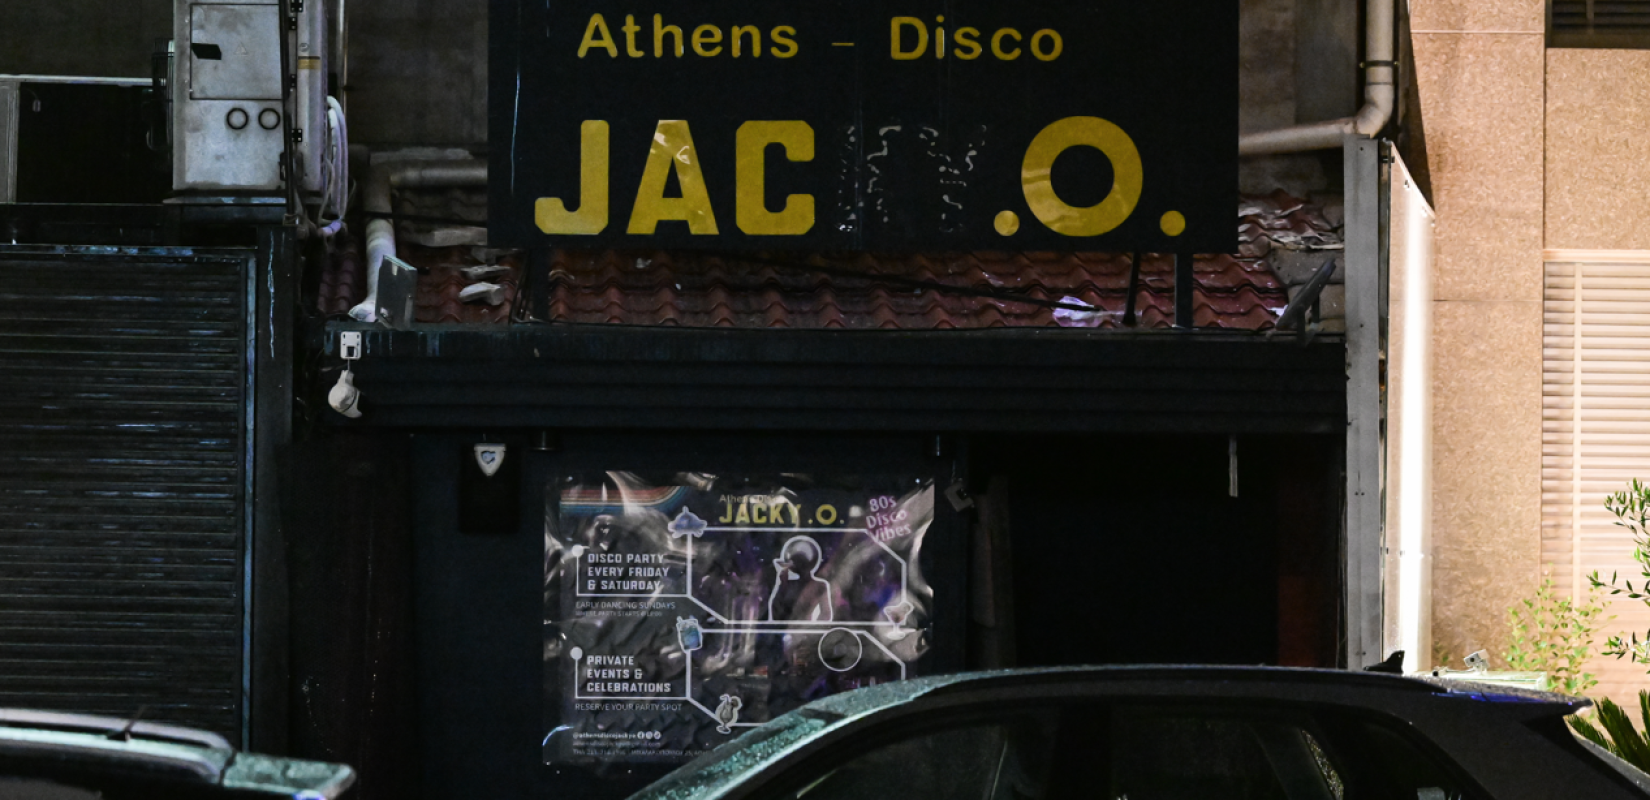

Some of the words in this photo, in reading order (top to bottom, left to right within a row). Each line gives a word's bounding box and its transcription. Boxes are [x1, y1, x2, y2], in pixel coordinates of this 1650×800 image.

[577, 13, 800, 59] Athens
[890, 15, 1063, 61] Disco
[869, 496, 896, 512] 80s
[866, 509, 907, 529] Disco
[869, 524, 911, 542] Vibes
[587, 553, 622, 564] DISCO
[626, 553, 664, 564] PARTY
[587, 567, 623, 577] EVERY
[628, 567, 669, 577] FRIDAY
[600, 580, 661, 590] SATURDAY
[586, 655, 634, 666] PRIVATE
[586, 669, 630, 679] EVENTS
[586, 682, 671, 692] CELEBRATIONS
[575, 703, 609, 711] RESERVE
[611, 703, 634, 711] YOUR
[635, 703, 659, 711] PARTY
[661, 703, 682, 711] SPOT
